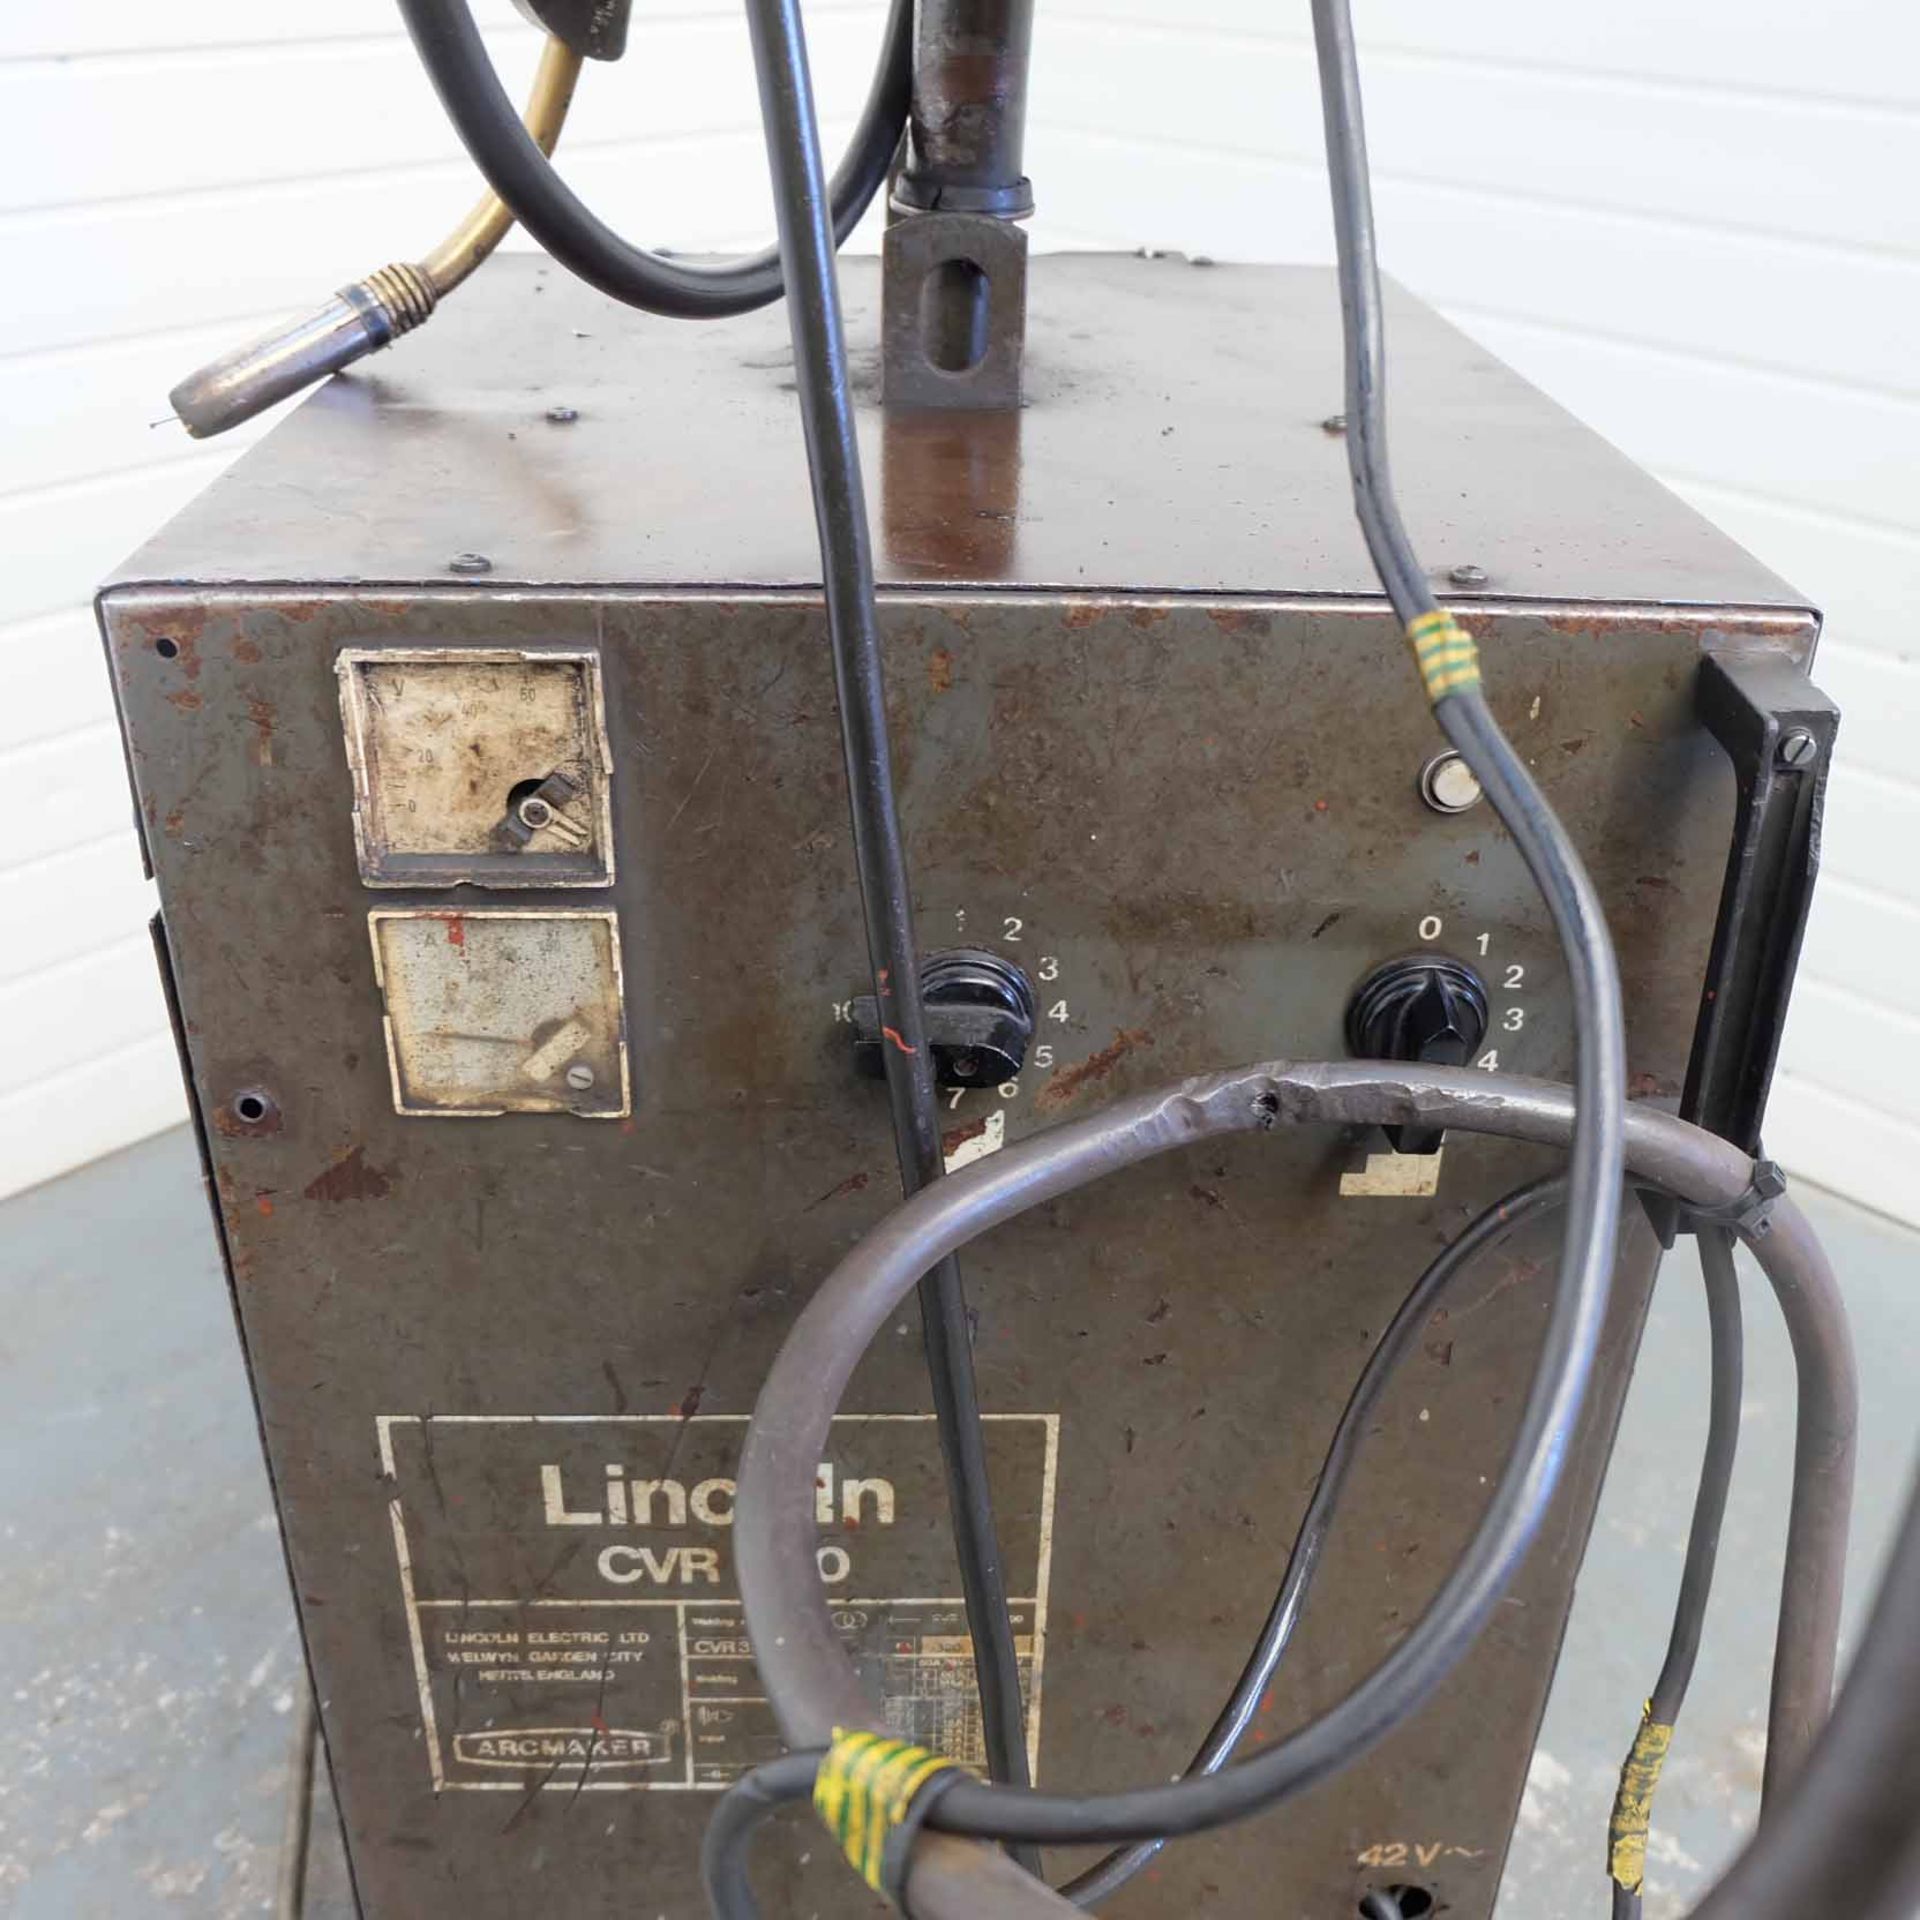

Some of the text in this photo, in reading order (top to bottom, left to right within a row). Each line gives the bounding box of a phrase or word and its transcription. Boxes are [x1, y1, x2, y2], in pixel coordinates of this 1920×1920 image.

[417, 749, 434, 763] 20
[1003, 916, 1023, 941] 2
[1418, 915, 1442, 940] 0
[1476, 932, 1490, 956] 1
[1038, 956, 1059, 981] 3
[1503, 964, 1524, 989] 2
[1047, 1000, 1070, 1023] 4
[1502, 1007, 1524, 1031] 3
[1033, 1045, 1054, 1068] 5
[1477, 1050, 1499, 1072] 4
[946, 1087, 966, 1110] 7
[541, 1463, 895, 1526] Lincln
[598, 1545, 721, 1585] CVR
[445, 1632, 650, 1644] LINCOLN ELECTRIC LTD
[447, 1651, 520, 1663] WELWYN
[528, 1651, 598, 1663] GARDEN
[477, 1739, 651, 1757] ARCMAKER
